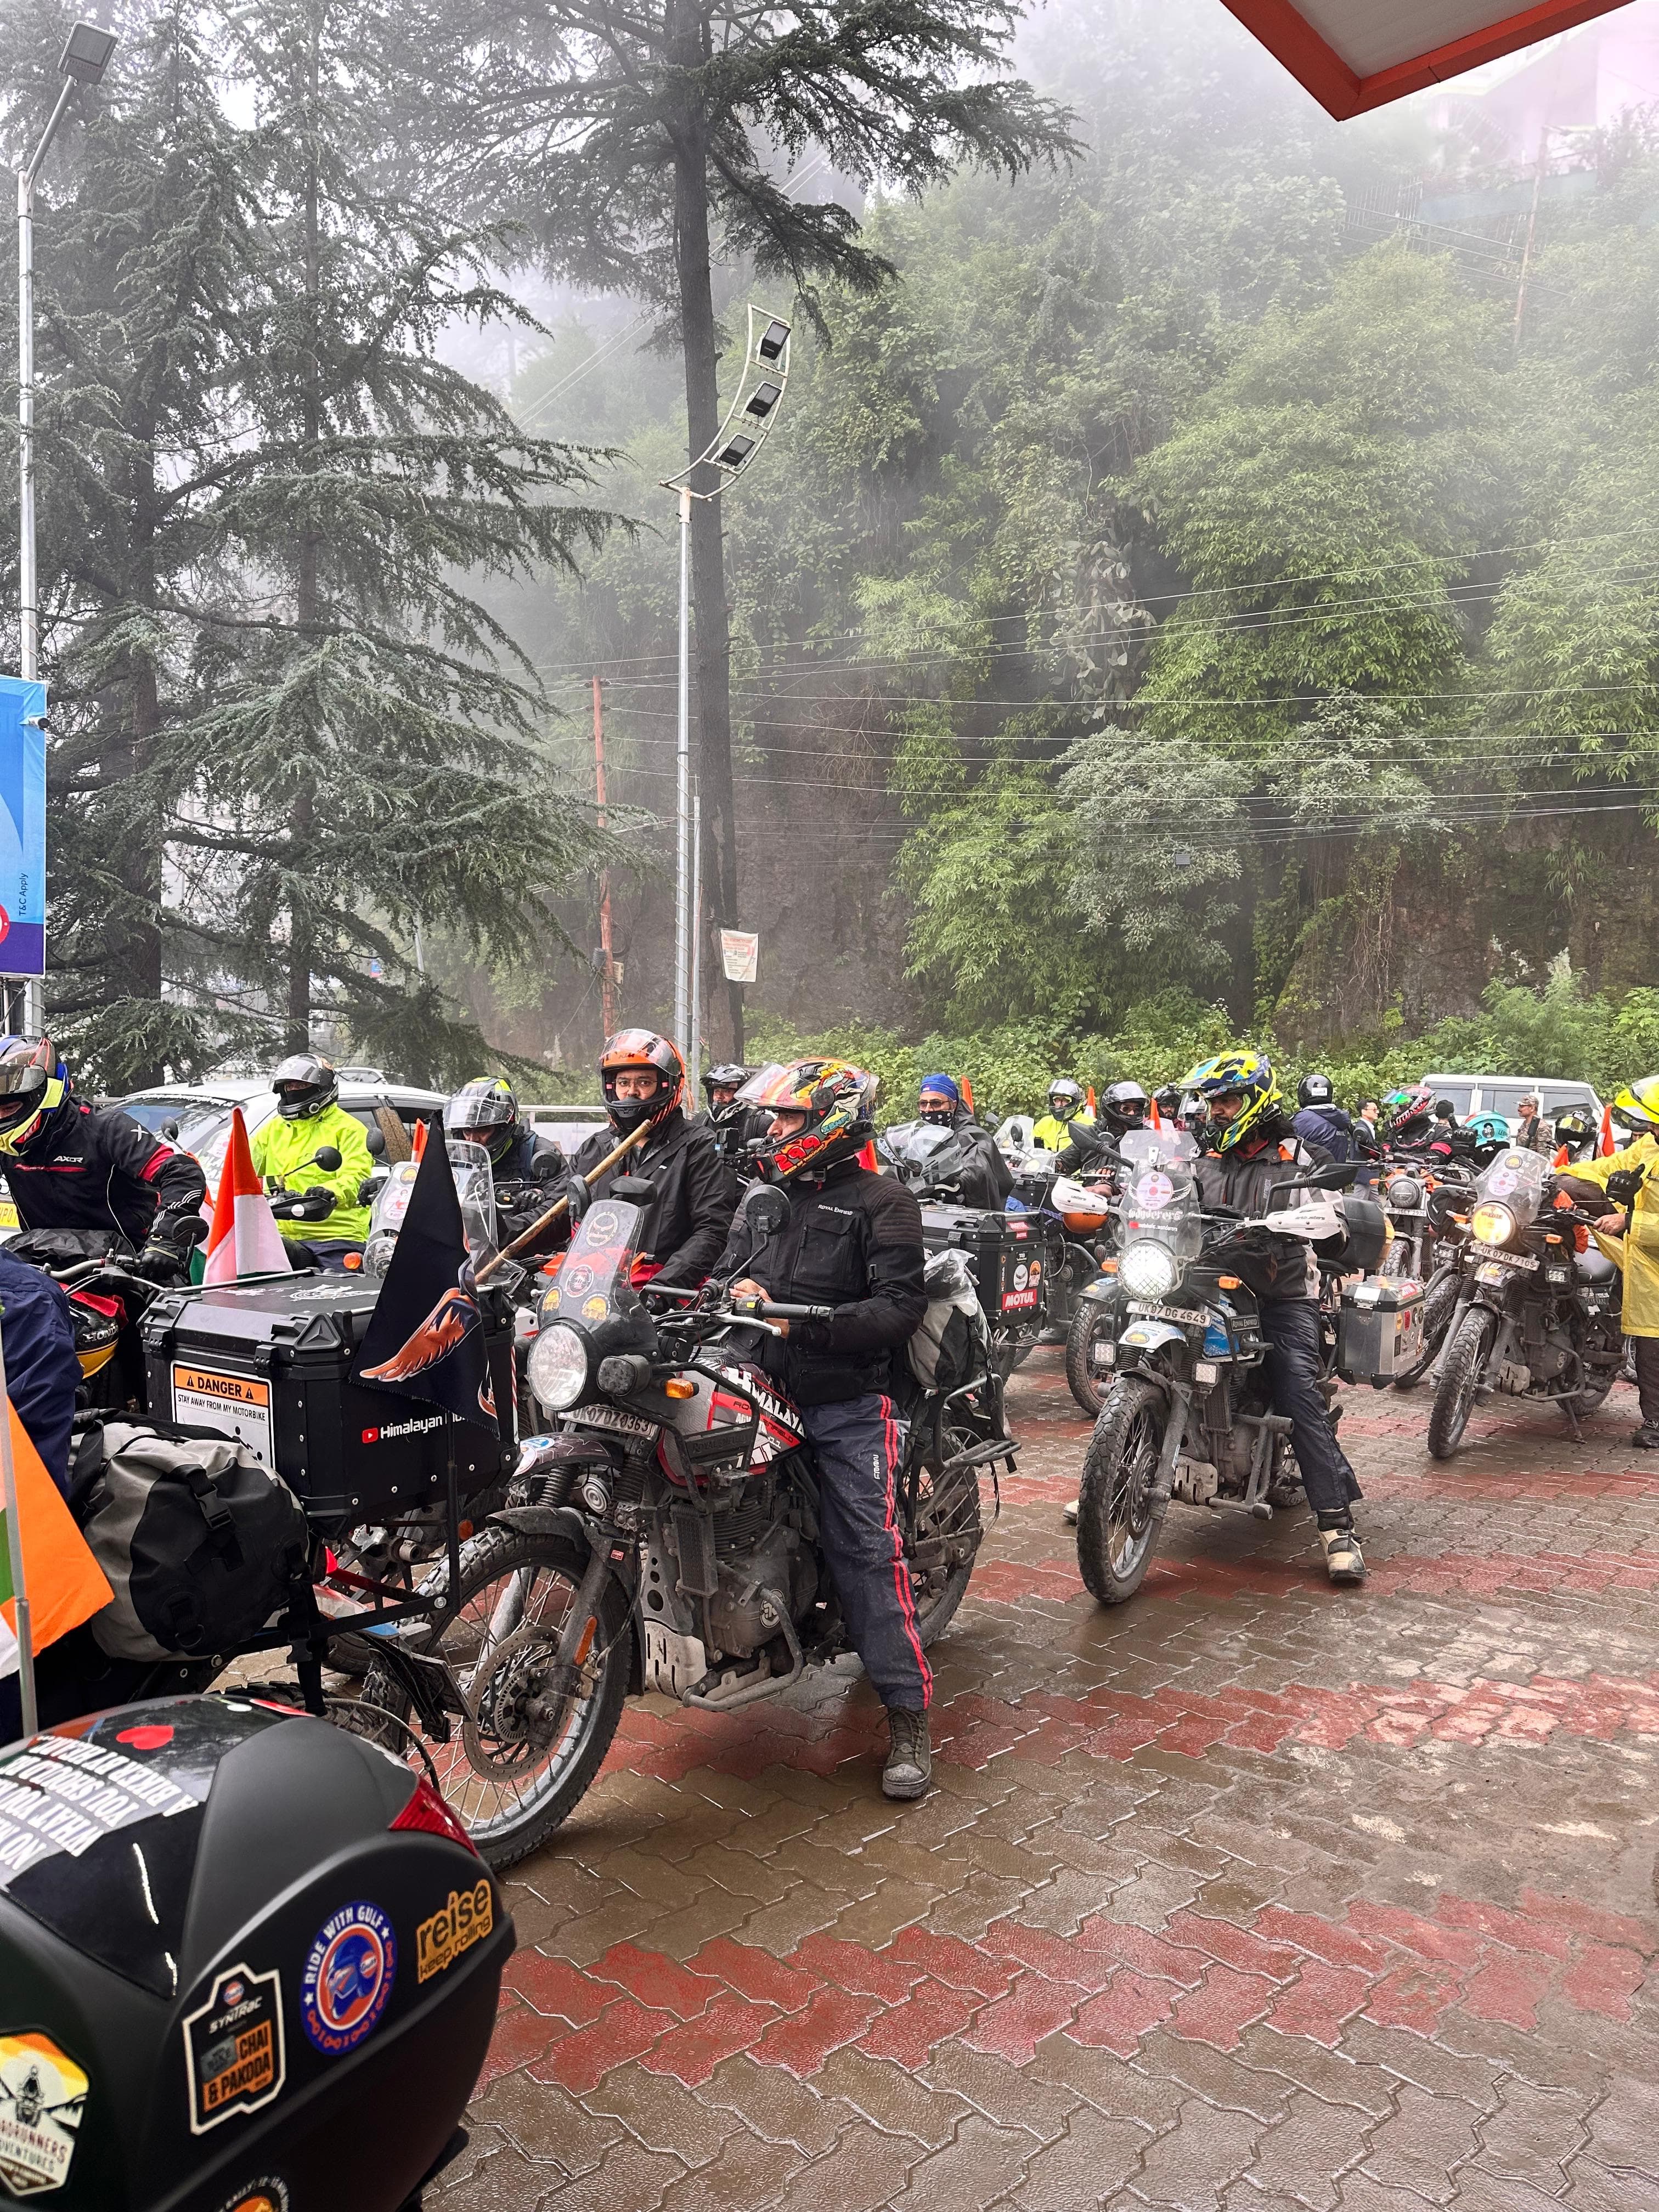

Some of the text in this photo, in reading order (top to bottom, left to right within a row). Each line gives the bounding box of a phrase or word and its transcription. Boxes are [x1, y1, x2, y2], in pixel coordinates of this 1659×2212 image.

[19, 873, 29, 916] T&C Apply
[53, 1155, 83, 1164] AXOR
[773, 1133, 822, 1172] 299
[834, 1206, 853, 1216] ENFIELD
[1481, 1247, 1493, 1255] UK
[1503, 1254, 1514, 1262] DK
[1514, 1258, 1536, 1268] 7105
[1005, 1291, 1034, 1307] MOTUL
[1165, 1307, 1178, 1318] DG
[1180, 1311, 1206, 1324] 4649
[1243, 1319, 1257, 1327] ENFIELD
[82, 1324, 119, 1343] HONDA
[198, 1376, 242, 1397] DANGER
[178, 1394, 266, 1421] STAY AWAY FROM MY MOTORBIKE
[380, 1415, 443, 1440] Himalayan
[80, 1751, 130, 1775] BY
[18, 1758, 105, 1802] SHOULD
[108, 1760, 182, 1807] BIKER
[80, 1787, 139, 1827] YOU
[162, 1794, 199, 1817] A
[27, 1802, 104, 1858] WHAT
[0, 1832, 47, 1870] NO
[420, 1885, 489, 1960] reise
[304, 1905, 384, 1984] RIDE WITH GULF
[419, 1916, 491, 1979] keep rolling
[239, 2025, 268, 2059] CHAI
[209, 2082, 219, 2105] &
[221, 2052, 270, 2099] PAKODA
